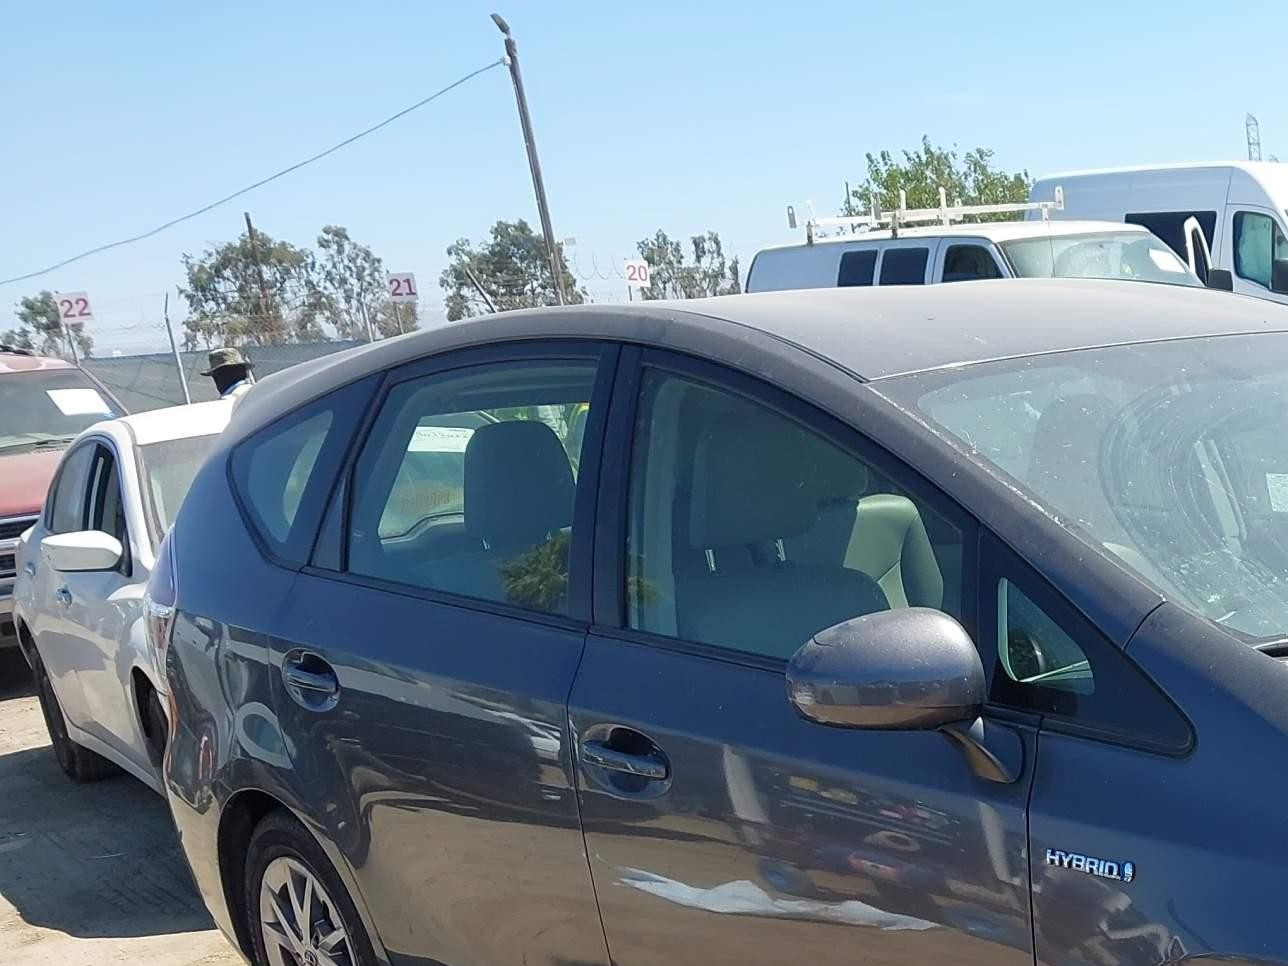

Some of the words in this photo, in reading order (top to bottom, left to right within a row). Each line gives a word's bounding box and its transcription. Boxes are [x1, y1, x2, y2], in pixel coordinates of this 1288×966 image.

[626, 264, 648, 281] 20
[389, 278, 417, 297] 21
[60, 298, 92, 318] 22
[1046, 848, 1121, 881] HYBRID
